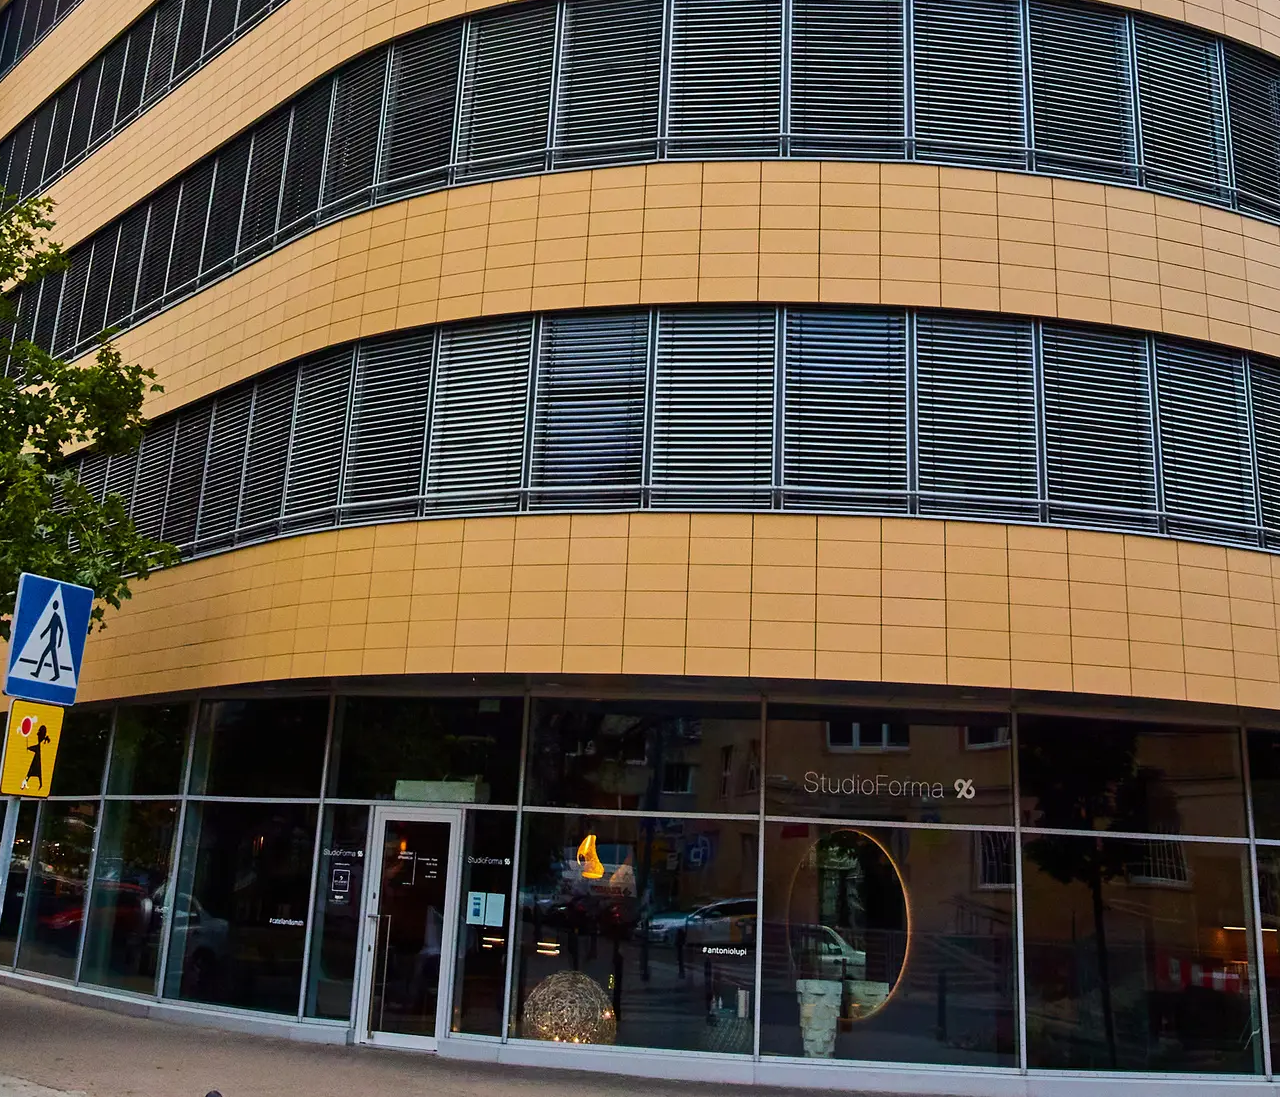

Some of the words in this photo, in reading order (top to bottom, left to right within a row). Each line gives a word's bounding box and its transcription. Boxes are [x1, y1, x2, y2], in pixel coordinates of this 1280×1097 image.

[803, 771, 945, 800] StudioForma
[467, 855, 503, 865] StudioForma
[702, 946, 747, 956] #antoniolupi
